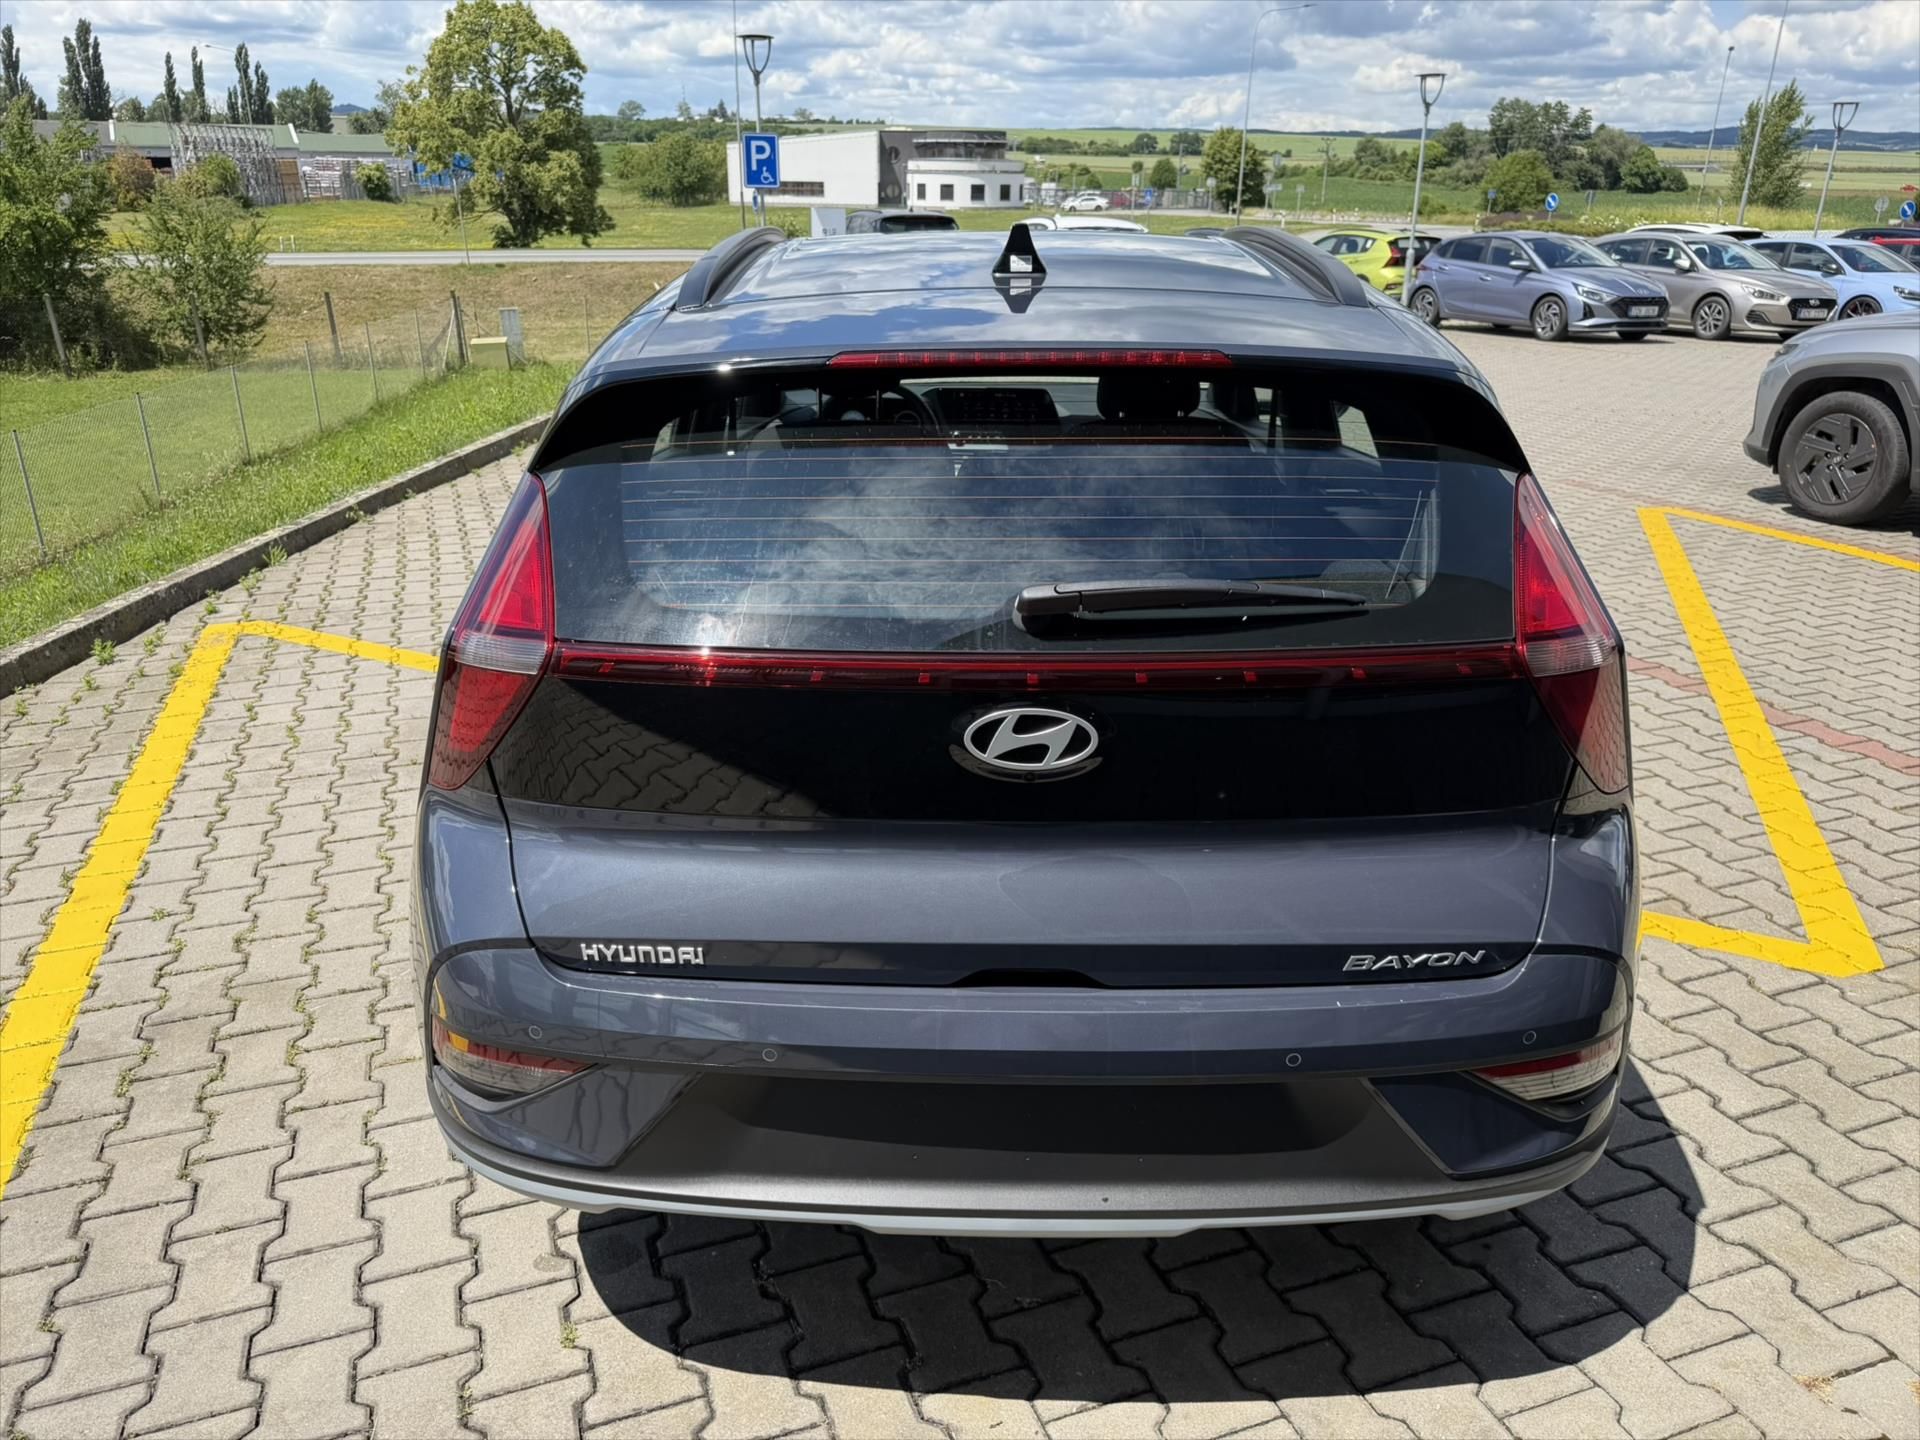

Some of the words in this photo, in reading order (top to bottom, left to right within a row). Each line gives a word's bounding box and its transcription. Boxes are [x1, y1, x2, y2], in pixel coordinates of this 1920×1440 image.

[750, 140, 771, 171] P
[580, 943, 704, 965] HYUNDAI
[1342, 950, 1486, 971] BAYON
